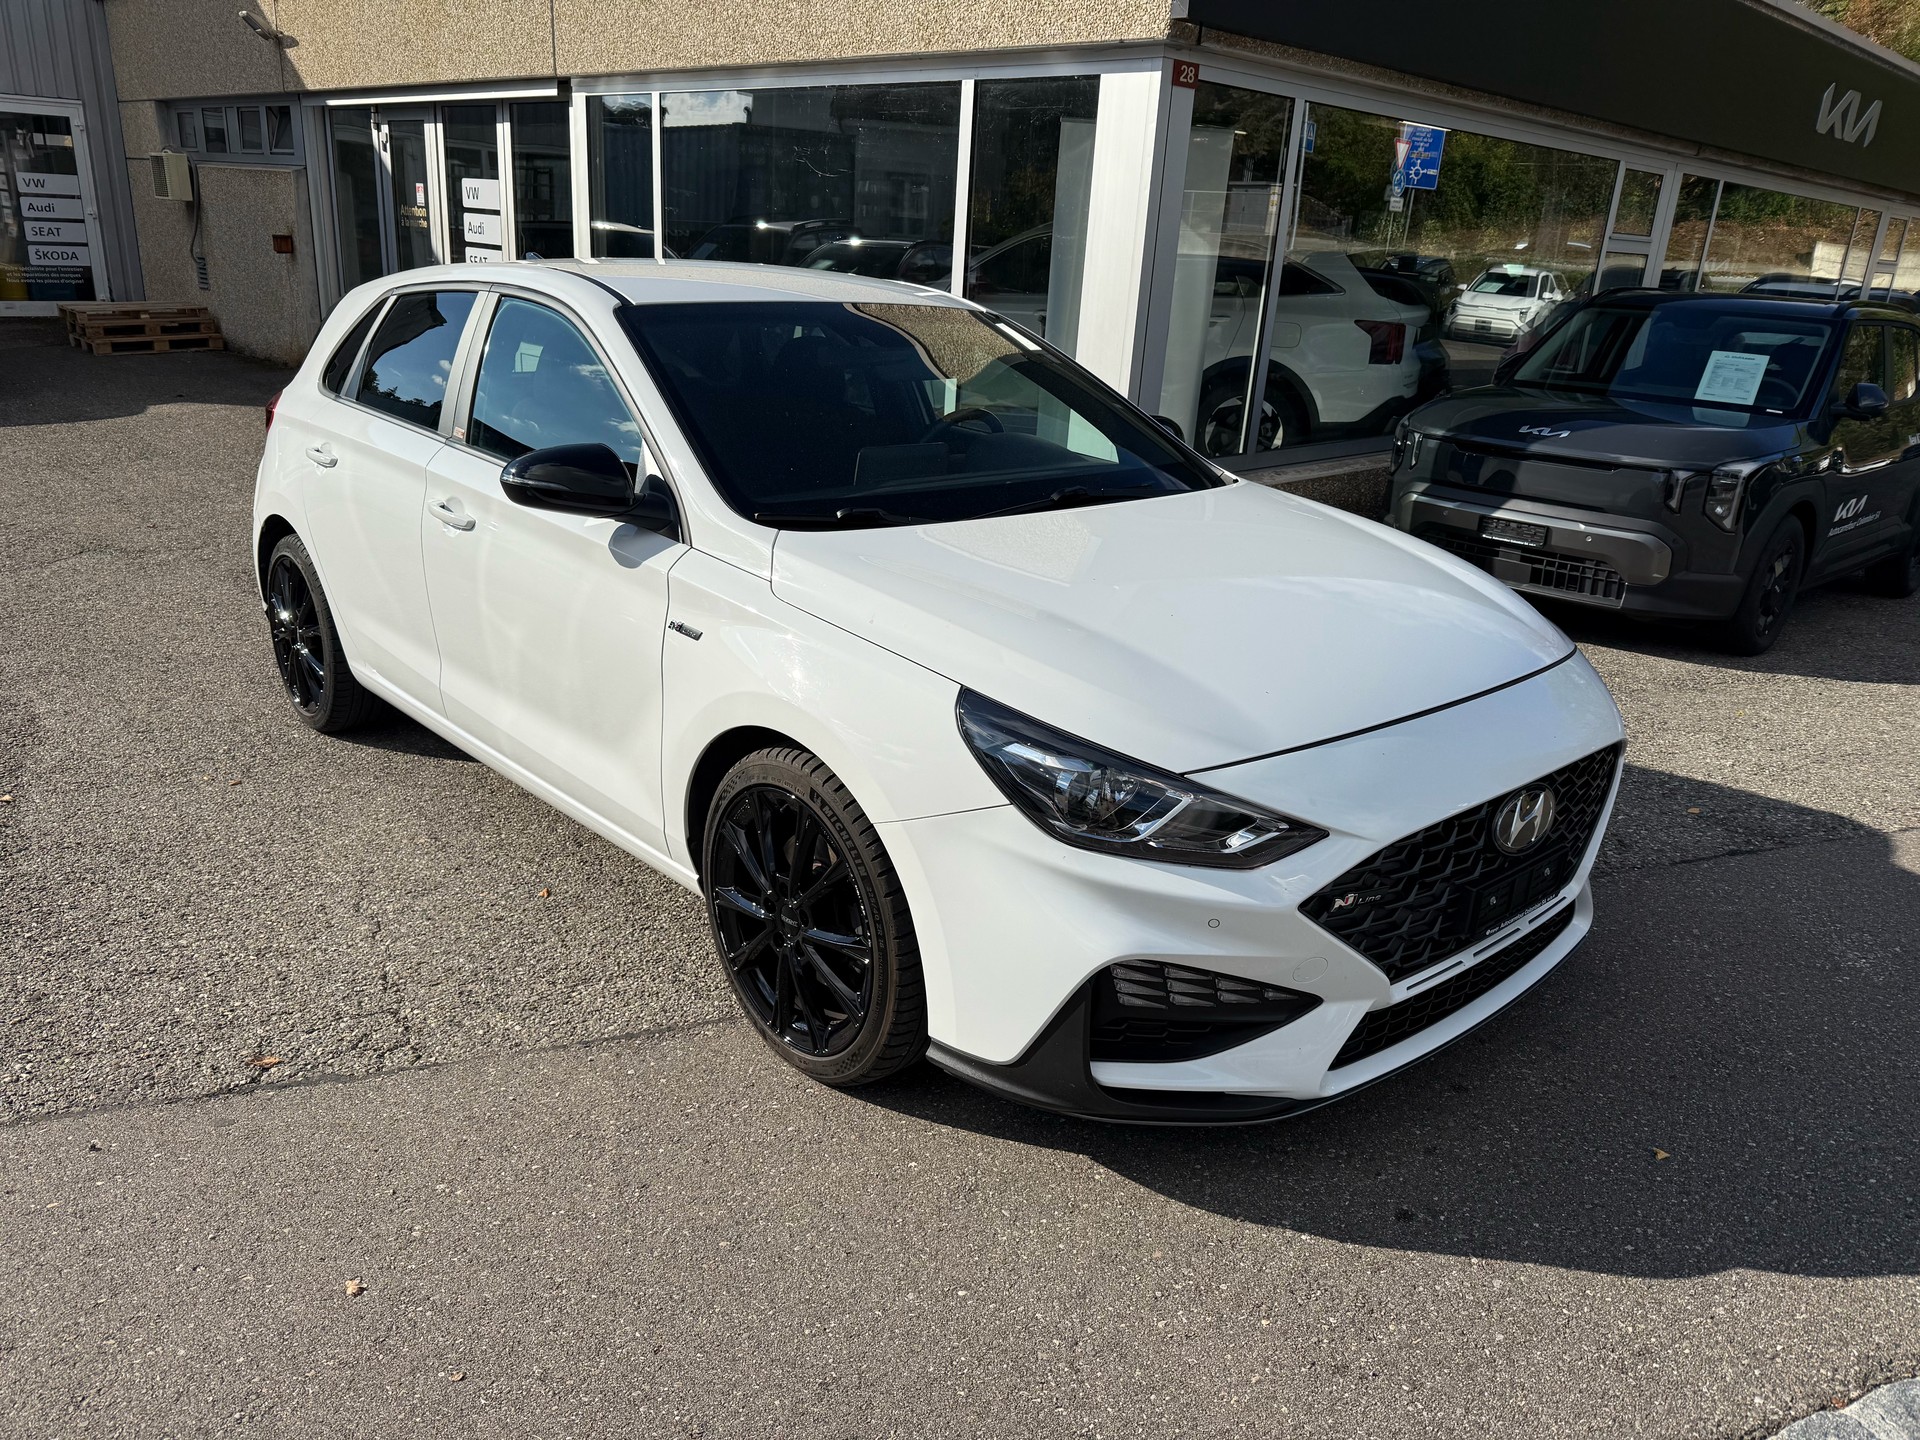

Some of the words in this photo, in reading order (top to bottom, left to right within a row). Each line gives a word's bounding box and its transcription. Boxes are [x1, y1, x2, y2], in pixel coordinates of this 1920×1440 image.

[1180, 65, 1195, 83] 28
[1816, 82, 1883, 148] KIA
[22, 177, 46, 188] VW
[465, 186, 480, 200] VW
[27, 202, 56, 213] Audi
[400, 204, 427, 218] Attention
[31, 226, 62, 237] SEAT
[467, 221, 485, 236] Audi
[34, 248, 80, 261] ŠKODA
[1518, 425, 1571, 438] KIA
[1833, 494, 1868, 523] KIA
[822, 804, 868, 877] MICHELIN
